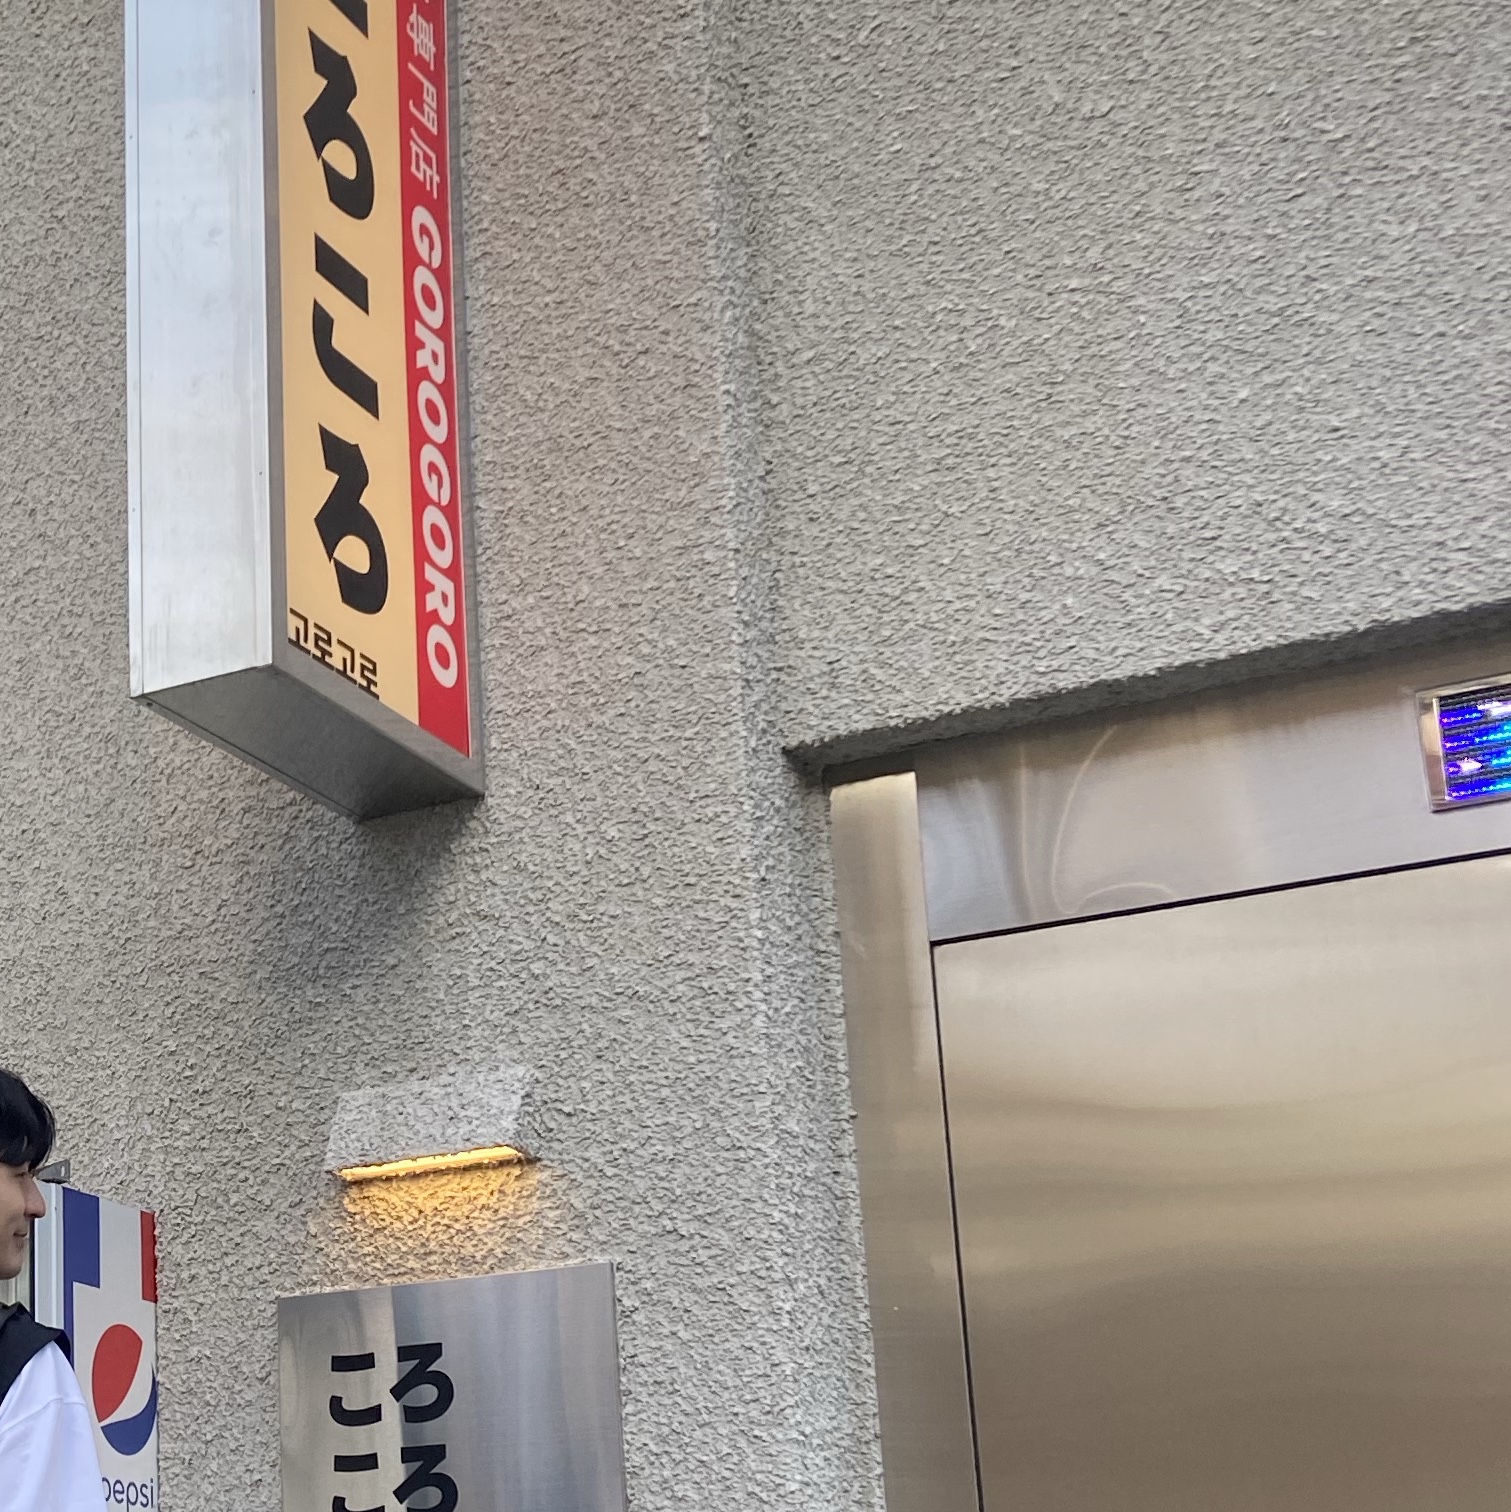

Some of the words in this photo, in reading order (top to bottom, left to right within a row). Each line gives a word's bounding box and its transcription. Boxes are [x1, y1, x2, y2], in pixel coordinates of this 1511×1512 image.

[407, 0, 440, 200] 専門店
[303, 0, 388, 614] ろころ
[411, 205, 459, 688] GOROGORO
[288, 607, 380, 701] 고로고로
[329, 1342, 454, 1426] ころ
